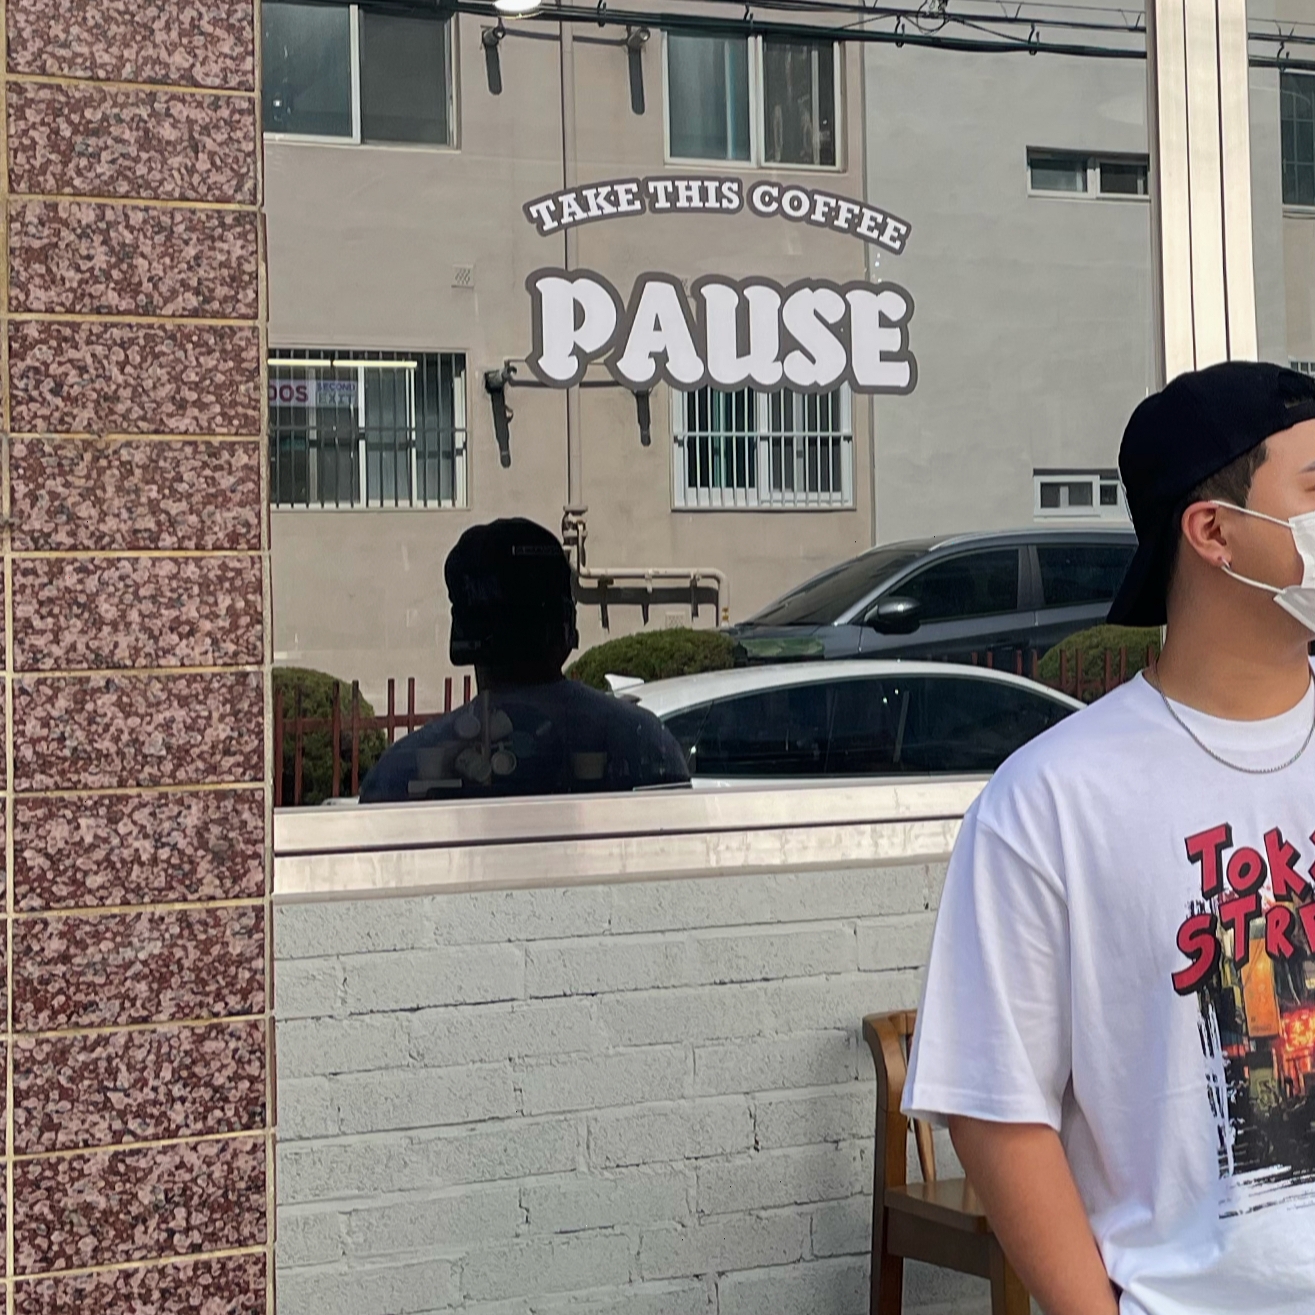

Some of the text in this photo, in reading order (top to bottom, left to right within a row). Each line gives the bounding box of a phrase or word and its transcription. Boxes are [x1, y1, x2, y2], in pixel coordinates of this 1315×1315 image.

[529, 180, 907, 250] TAKE THIS COFFEE
[535, 277, 910, 387] PAUSE
